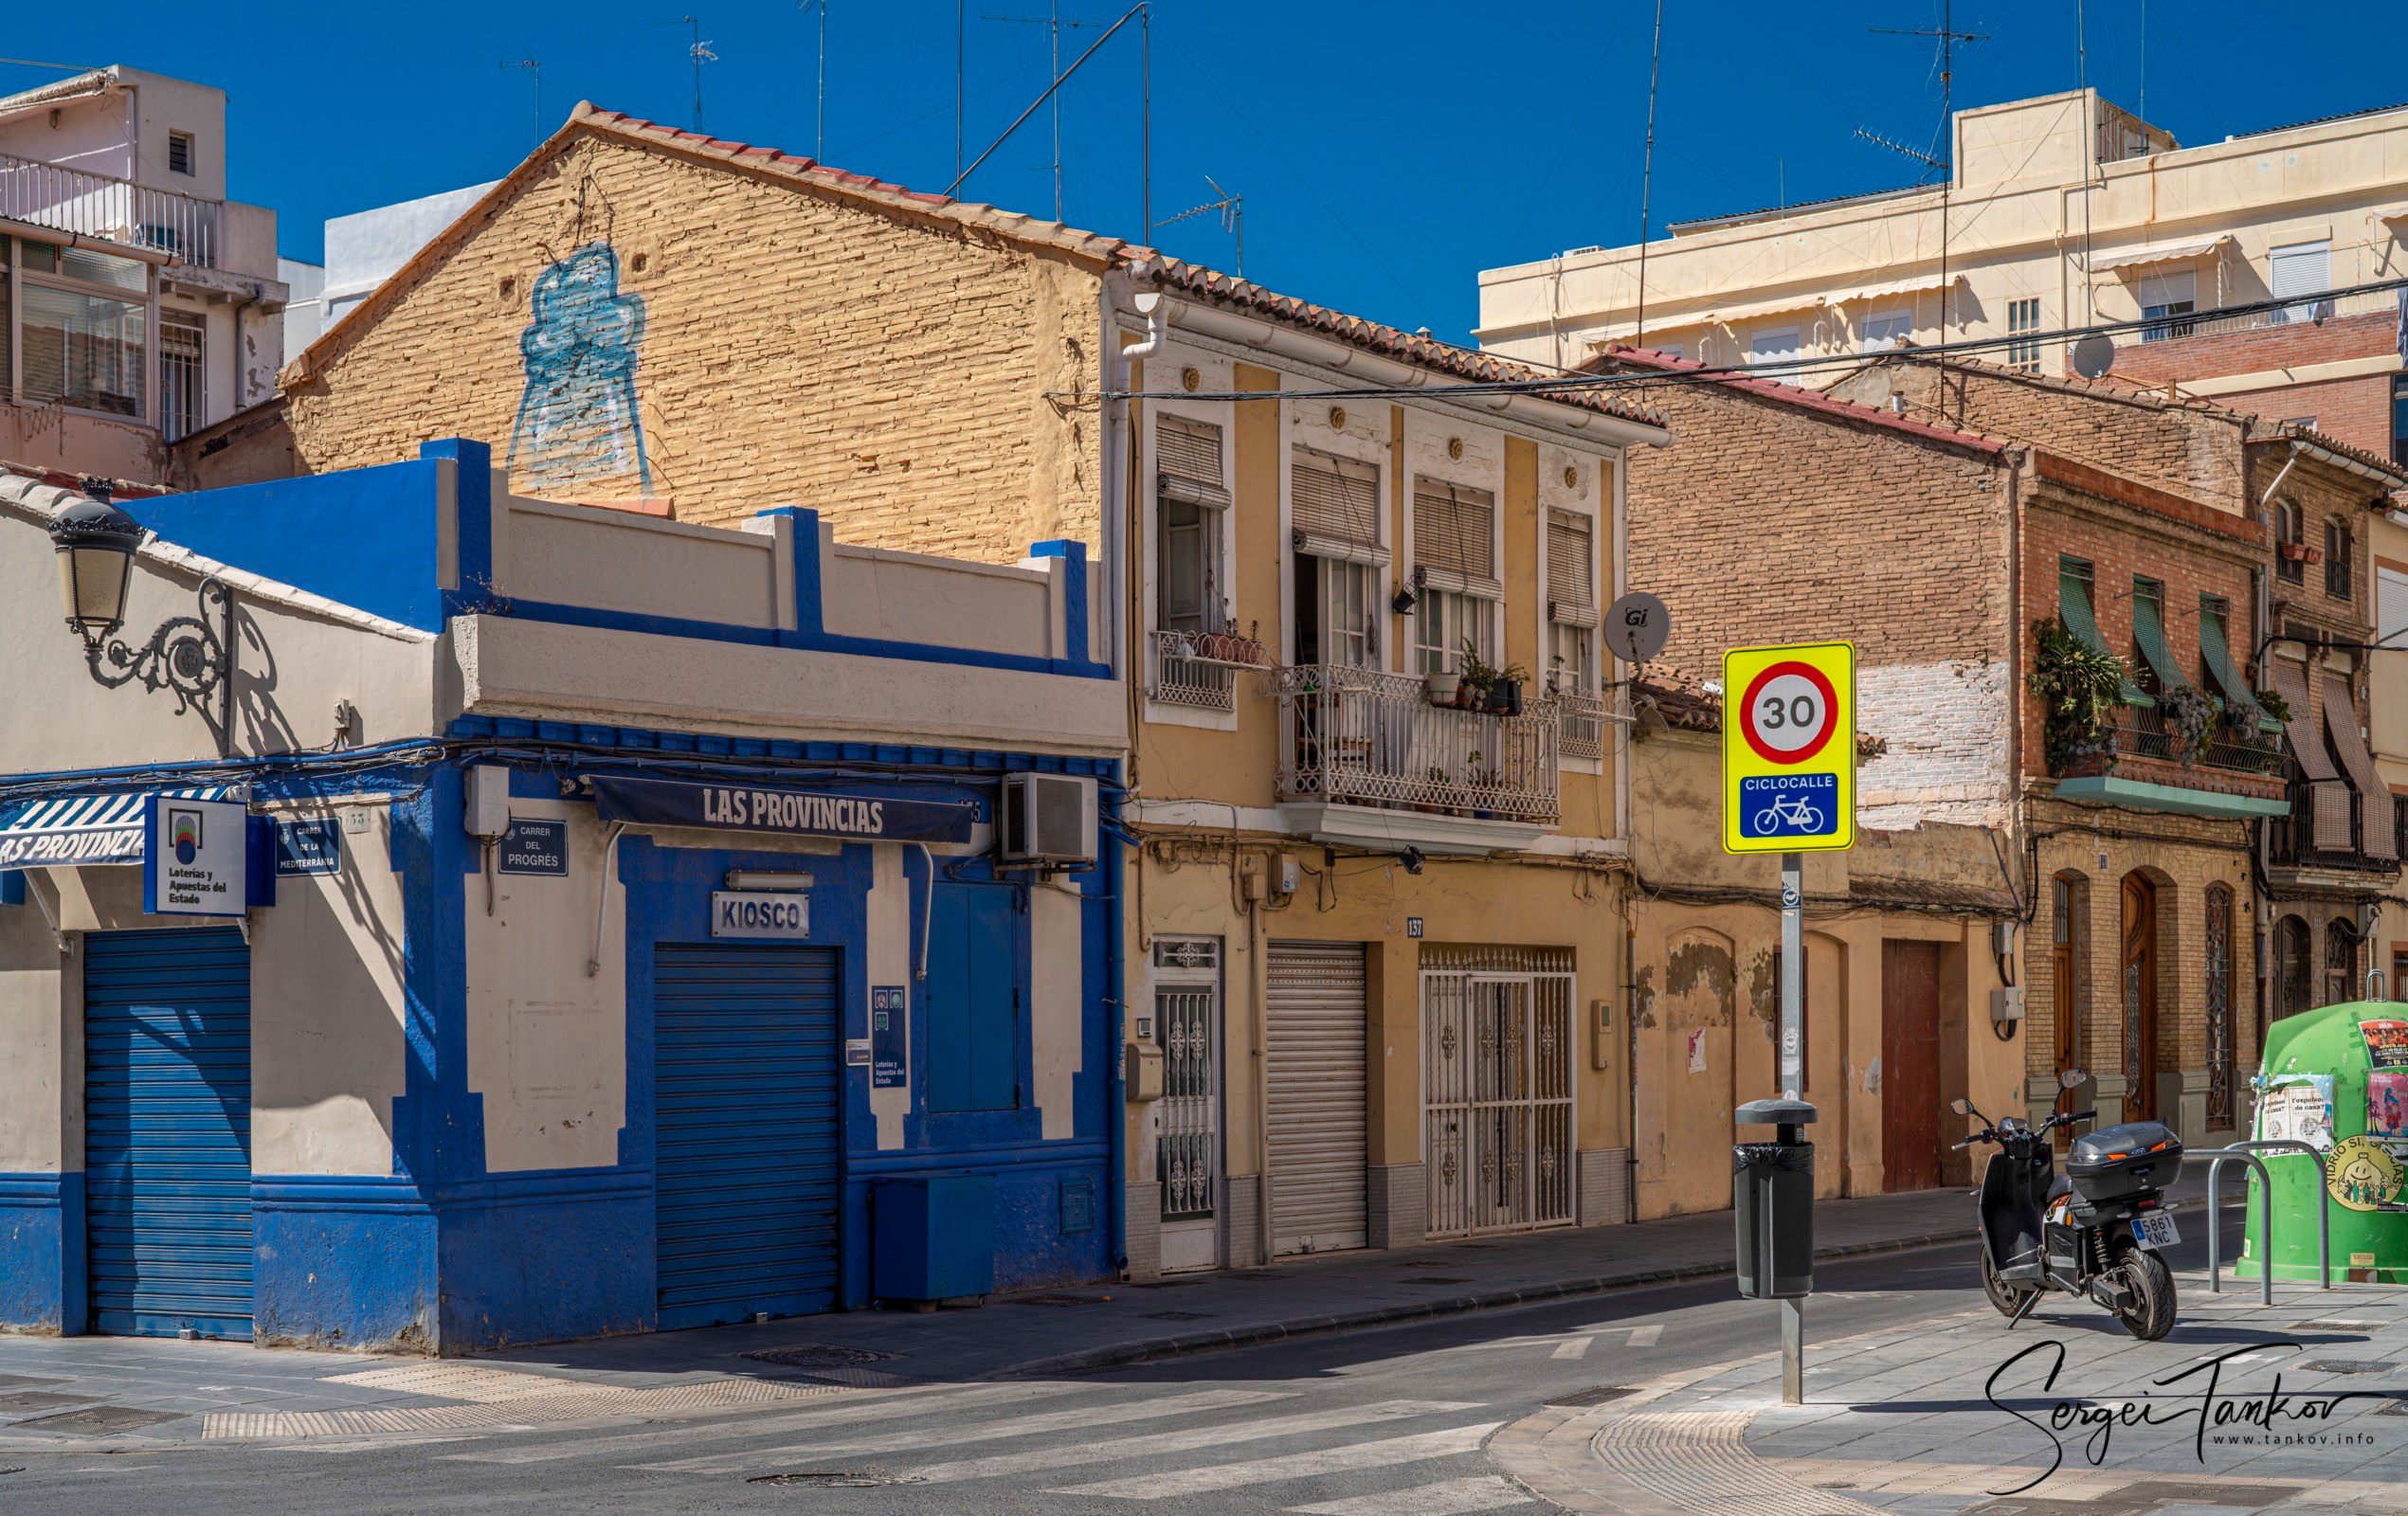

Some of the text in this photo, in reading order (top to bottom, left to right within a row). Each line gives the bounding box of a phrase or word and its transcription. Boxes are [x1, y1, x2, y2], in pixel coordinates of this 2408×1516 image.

[1762, 695, 1816, 730] 30
[1745, 775, 1833, 790] CICLOCALLE
[703, 788, 883, 835] LAS PROVINCIAS
[297, 826, 322, 835] CARRER
[520, 826, 551, 836] CARRER
[525, 841, 541, 850] DEL
[169, 867, 213, 882] Loterías y
[169, 880, 226, 893] Apuestas del
[169, 893, 201, 904] Estado
[721, 900, 800, 929] KIOSCO
[1408, 919, 1422, 935] 137
[2327, 1145, 2346, 1186] VIDRIO
[2143, 1217, 2172, 1233] 5861
[2146, 1231, 2170, 1246] KNC
